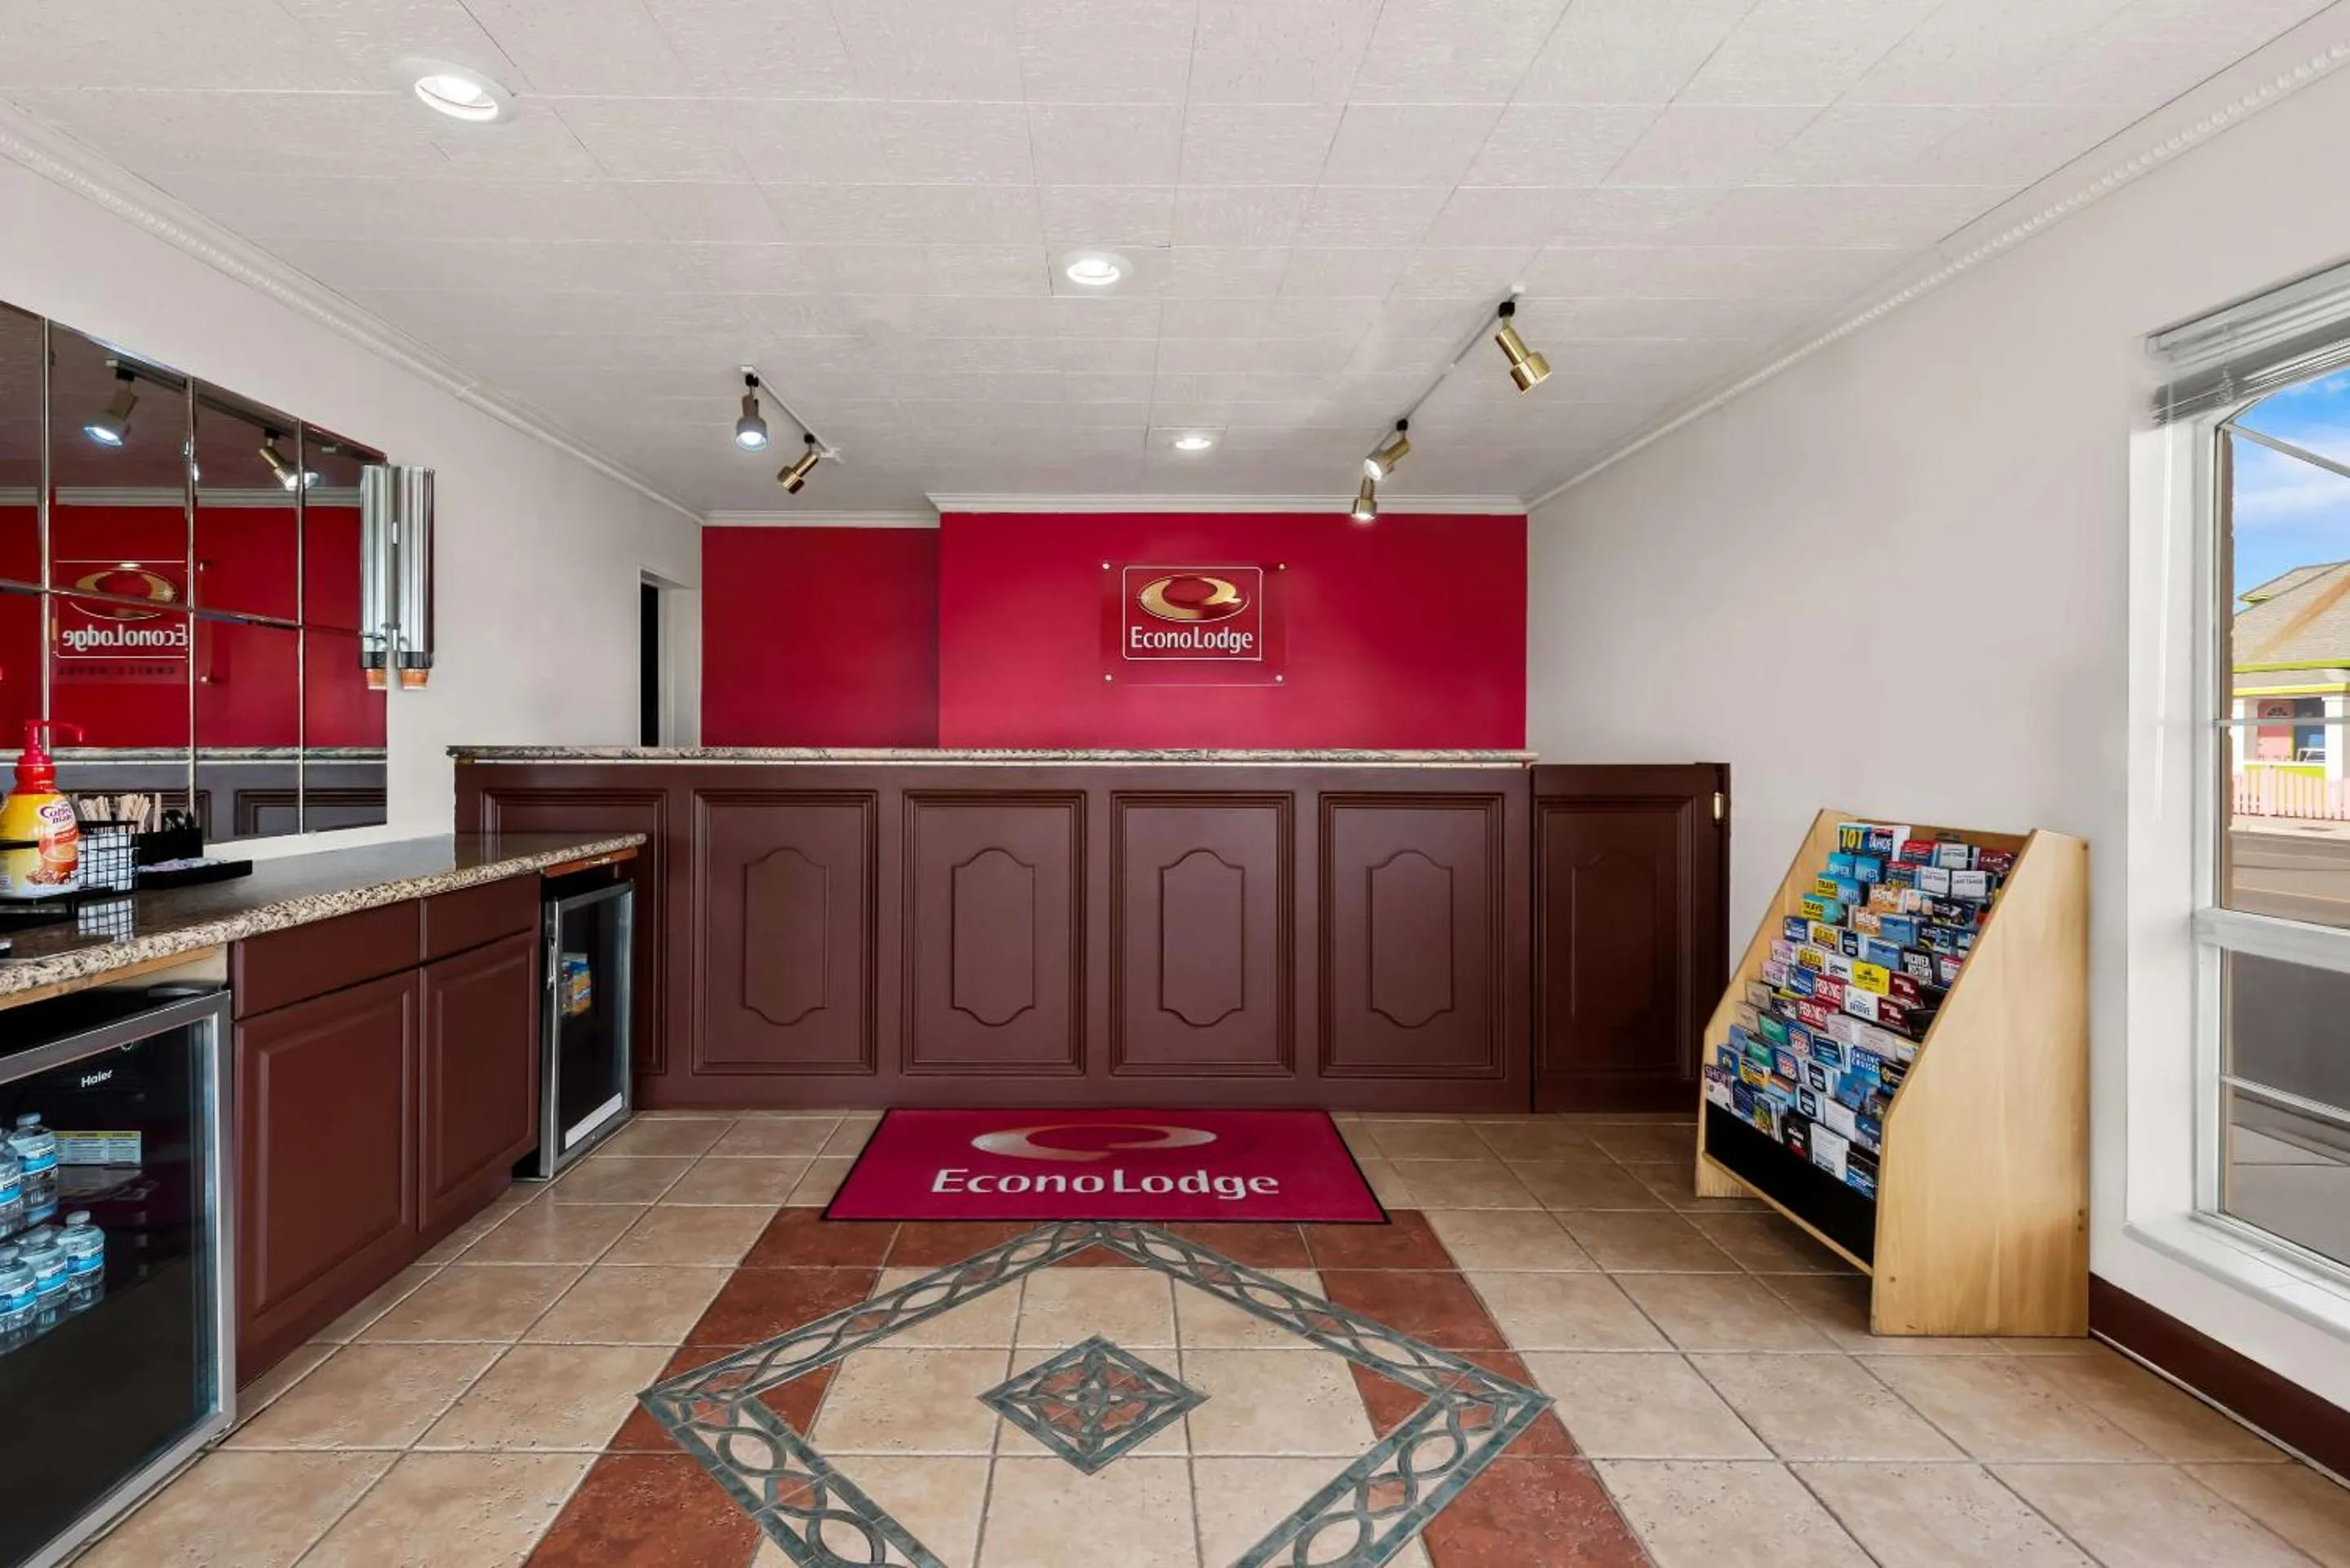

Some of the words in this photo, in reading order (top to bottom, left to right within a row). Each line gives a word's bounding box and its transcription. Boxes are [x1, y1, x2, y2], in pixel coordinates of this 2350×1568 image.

[1130, 626, 1254, 653] EconoLodge
[1840, 828, 1863, 849] 101
[81, 1070, 113, 1087] Haier
[931, 1168, 1280, 1200] EconoLodge
